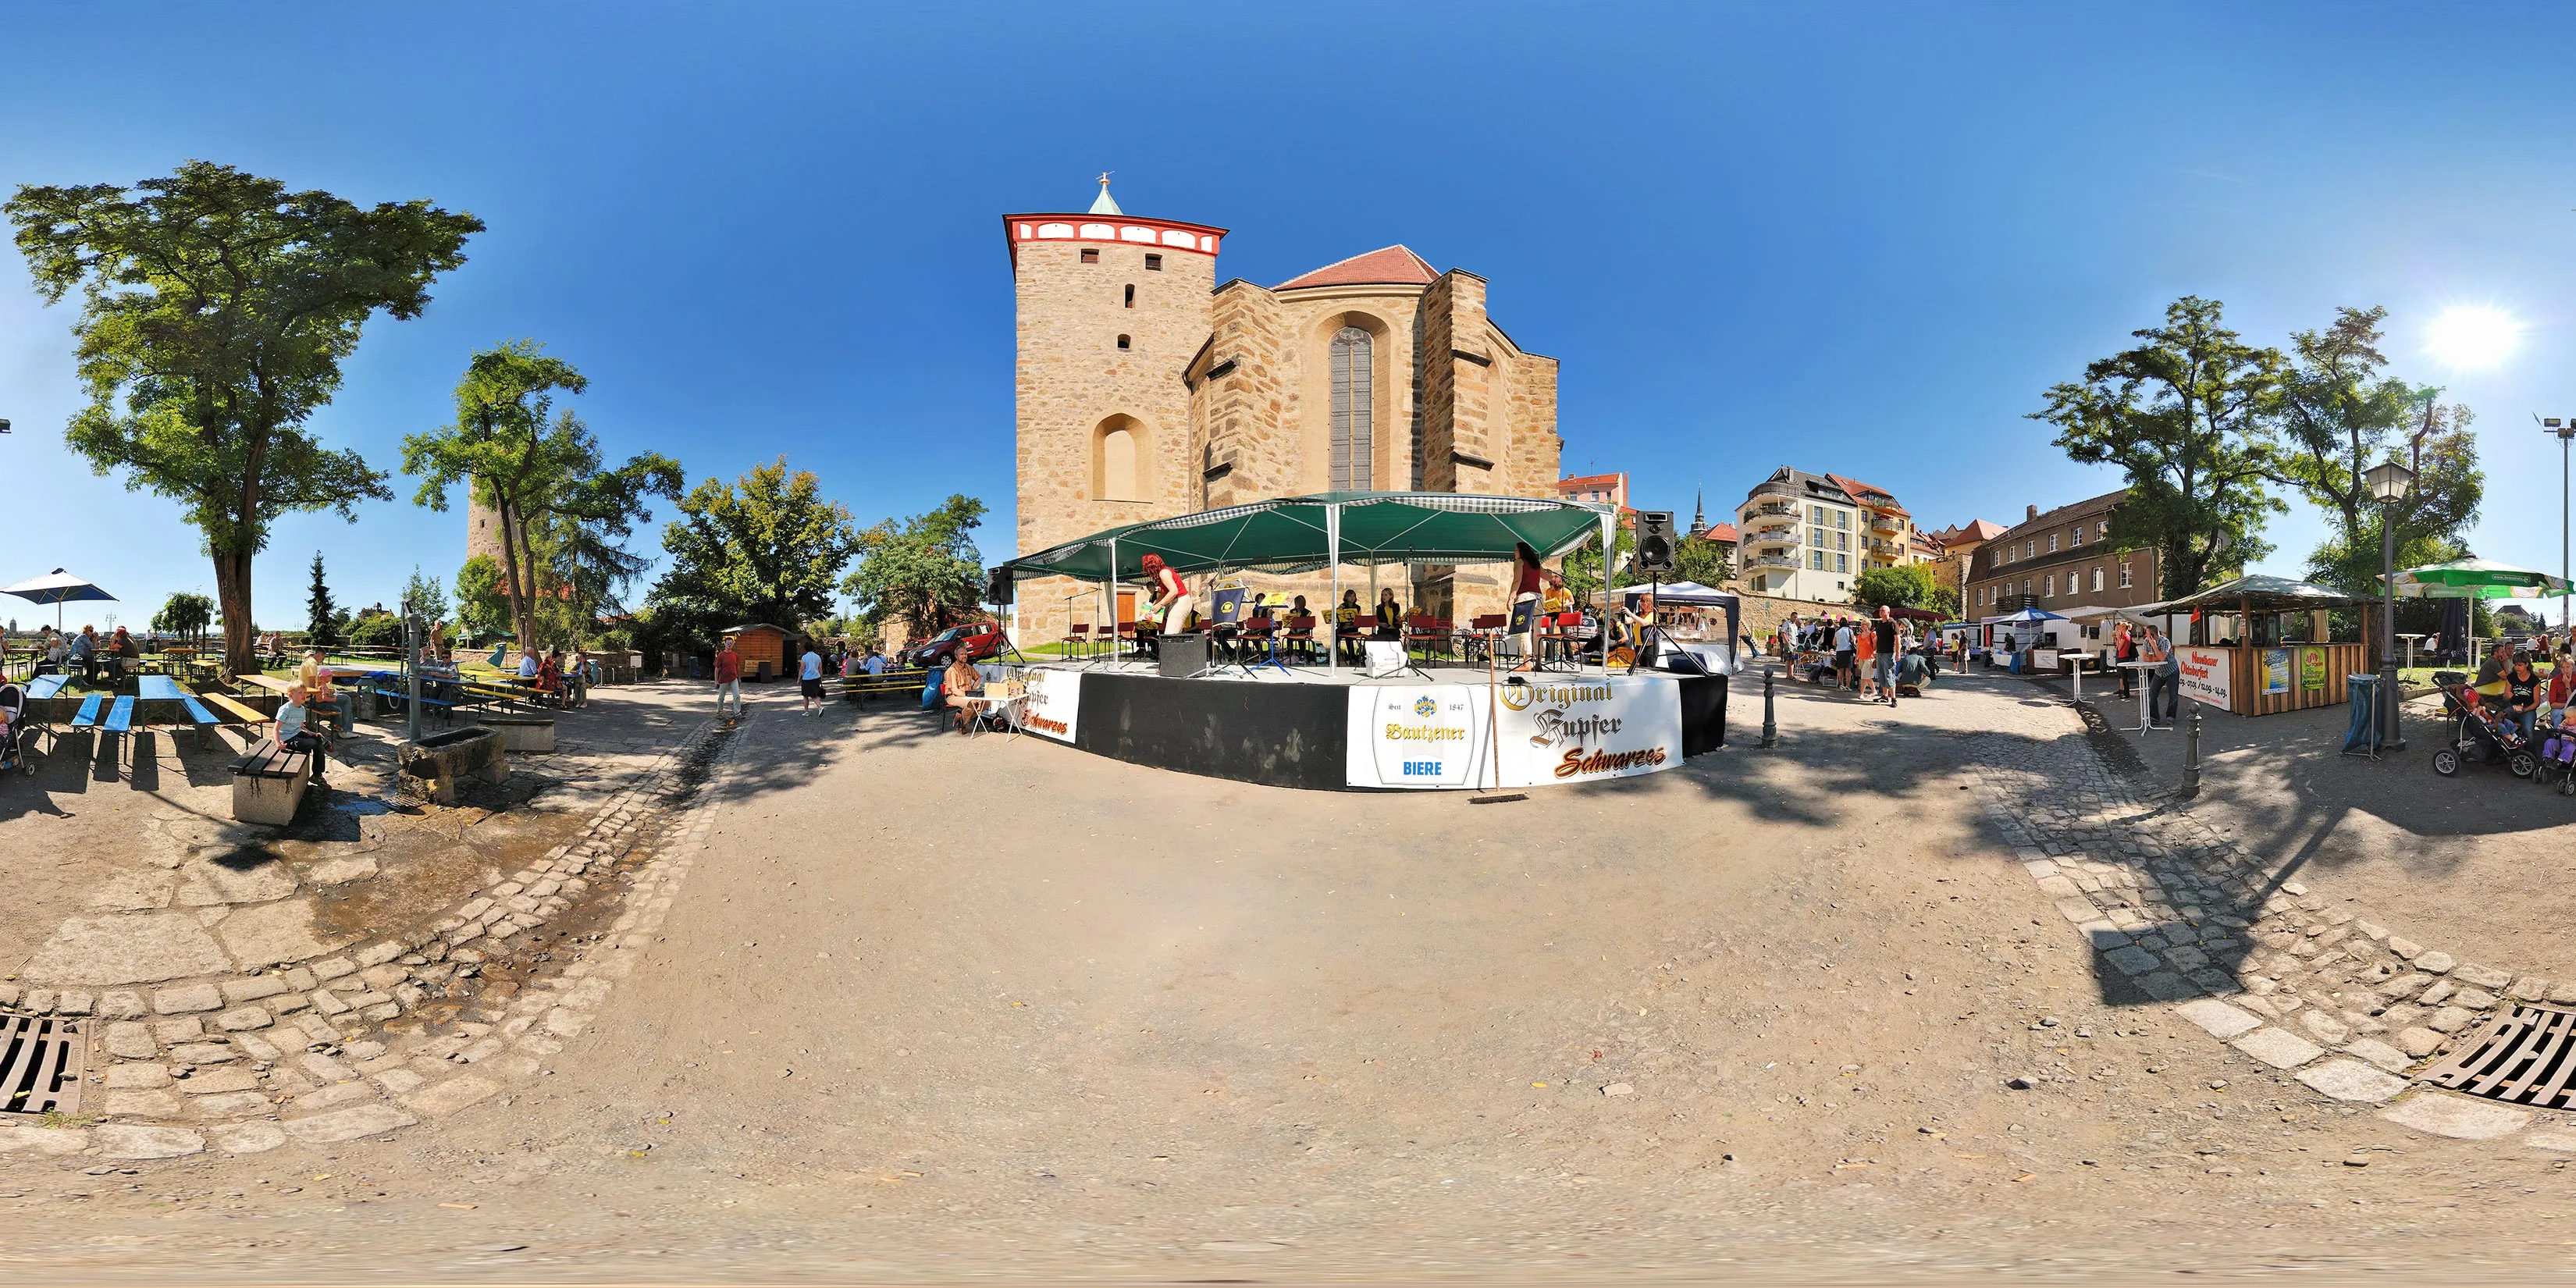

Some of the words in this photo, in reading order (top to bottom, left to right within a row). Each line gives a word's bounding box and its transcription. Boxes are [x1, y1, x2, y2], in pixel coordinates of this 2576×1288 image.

[1006, 667, 1046, 685] Original
[2180, 660, 2209, 681] Oktoberfest
[1499, 682, 1614, 711] Original
[1021, 710, 1067, 735] Schwarzes
[1385, 723, 1465, 743] Bautzener
[1530, 709, 1622, 748] Kupfer
[1403, 761, 1442, 776] BIERE
[1553, 745, 1667, 779] Schwarzes
